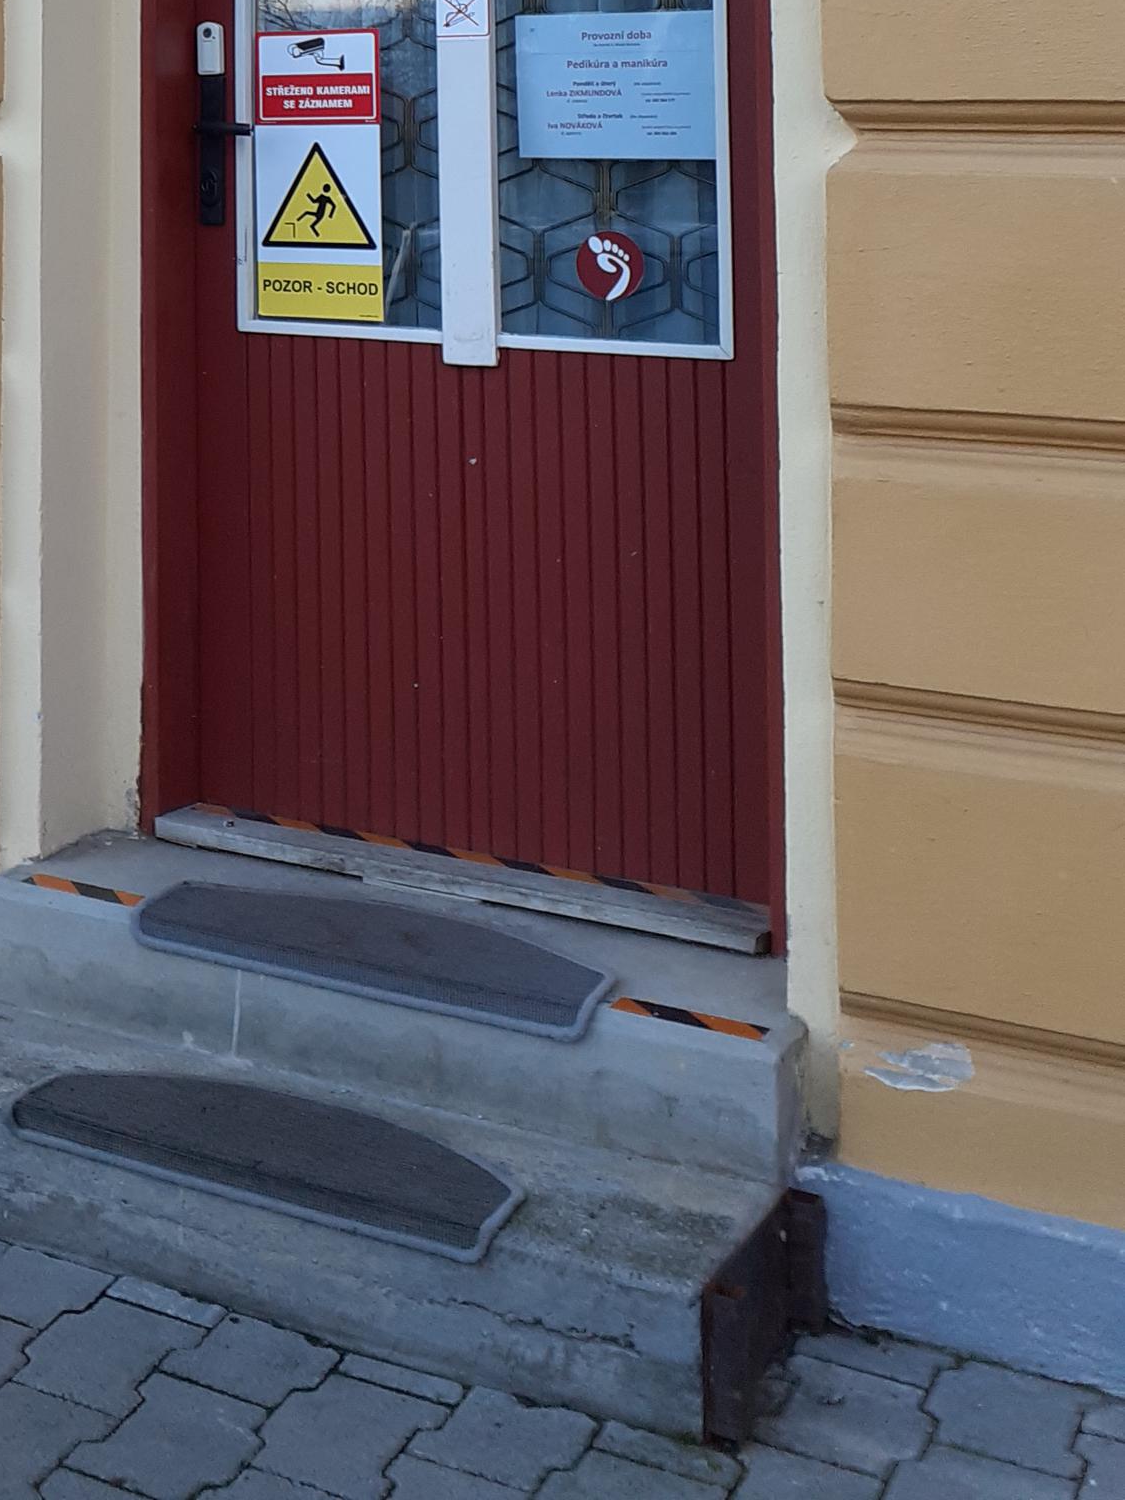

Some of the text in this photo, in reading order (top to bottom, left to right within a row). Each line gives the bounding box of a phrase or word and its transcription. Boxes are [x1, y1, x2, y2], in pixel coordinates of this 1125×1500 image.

[581, 30, 652, 41] Provozní doba
[567, 59, 610, 69] Pedikúra
[621, 58, 668, 68] manikúra
[265, 84, 371, 97] STŘEŽENO KAMERAMI
[282, 98, 353, 109] SE ZÁZNAMEM
[262, 279, 313, 293] POZOR
[325, 281, 379, 296] SCHOD
